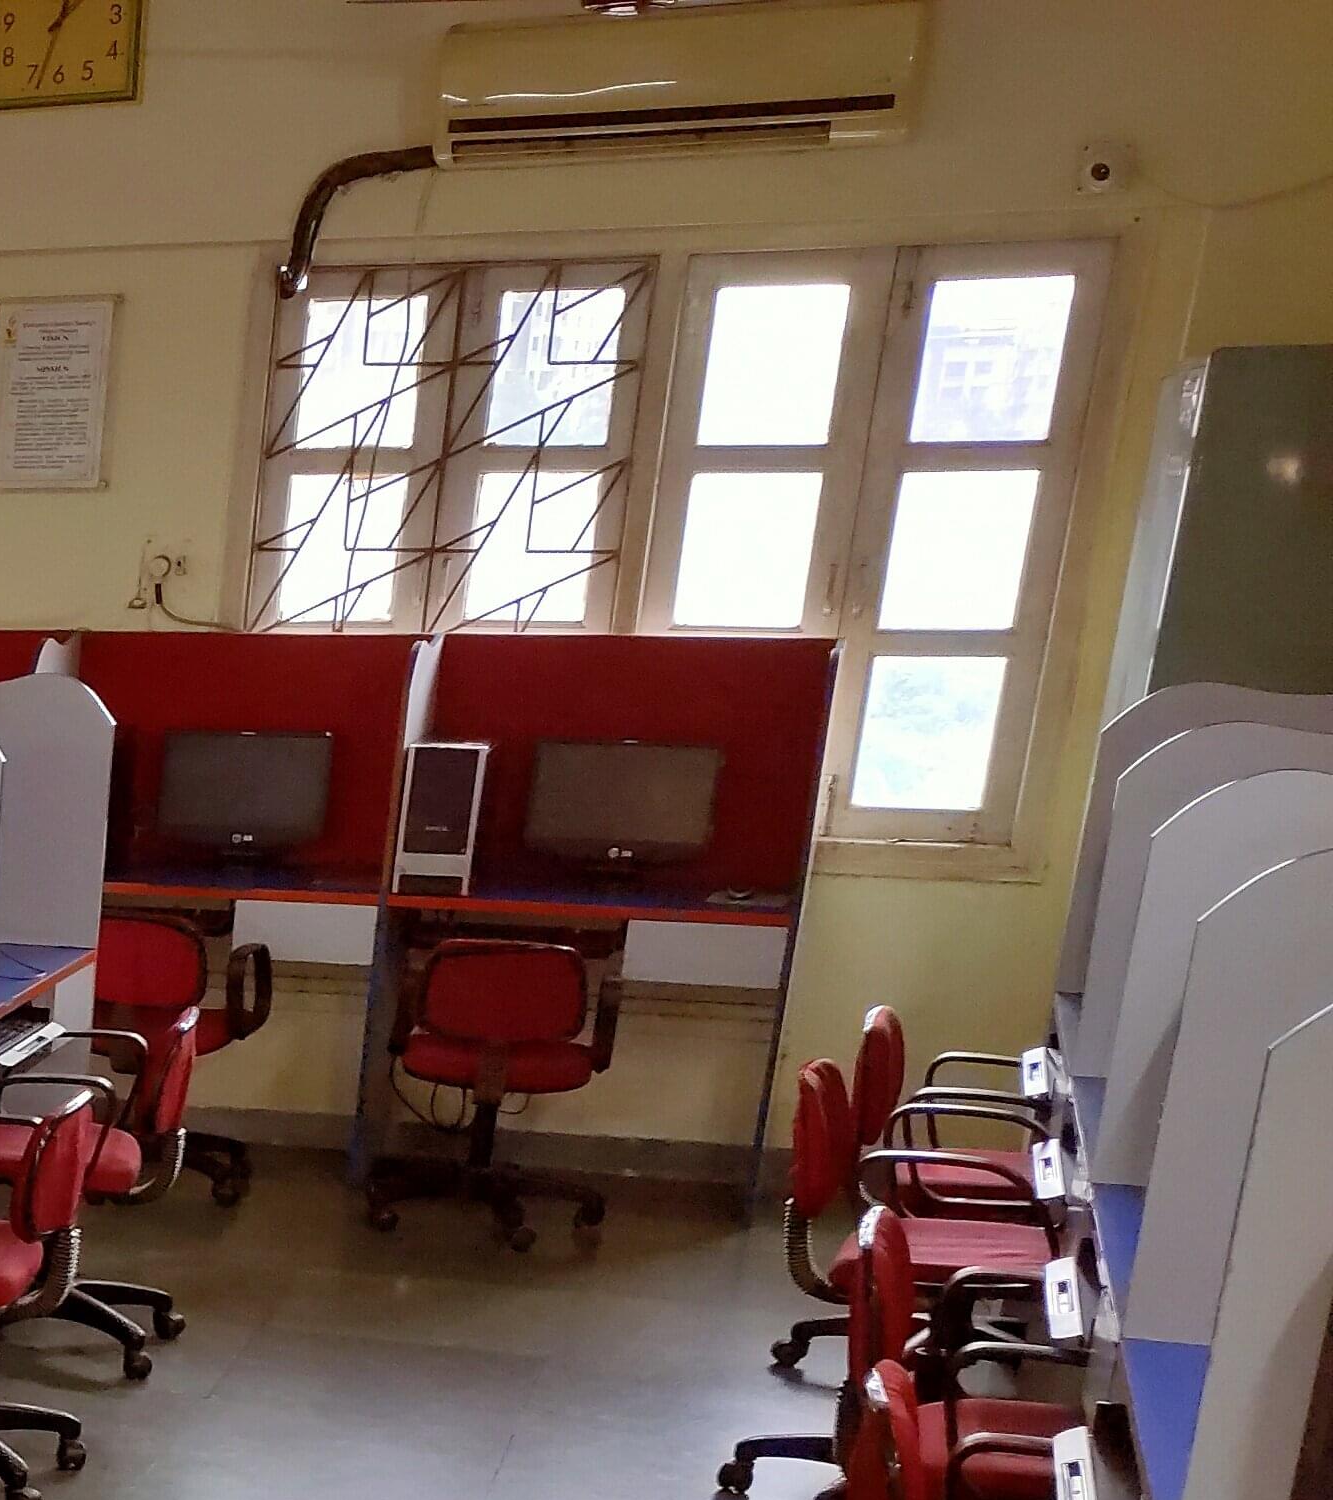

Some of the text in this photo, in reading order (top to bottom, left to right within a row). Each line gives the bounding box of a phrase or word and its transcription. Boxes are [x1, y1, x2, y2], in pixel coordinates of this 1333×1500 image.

[3, 12, 15, 33] 9
[109, 4, 122, 24] 3
[2, 47, 14, 66] 8
[106, 40, 119, 60] 4
[26, 64, 38, 84] 7
[53, 65, 65, 84] 6
[82, 60, 94, 81] 5
